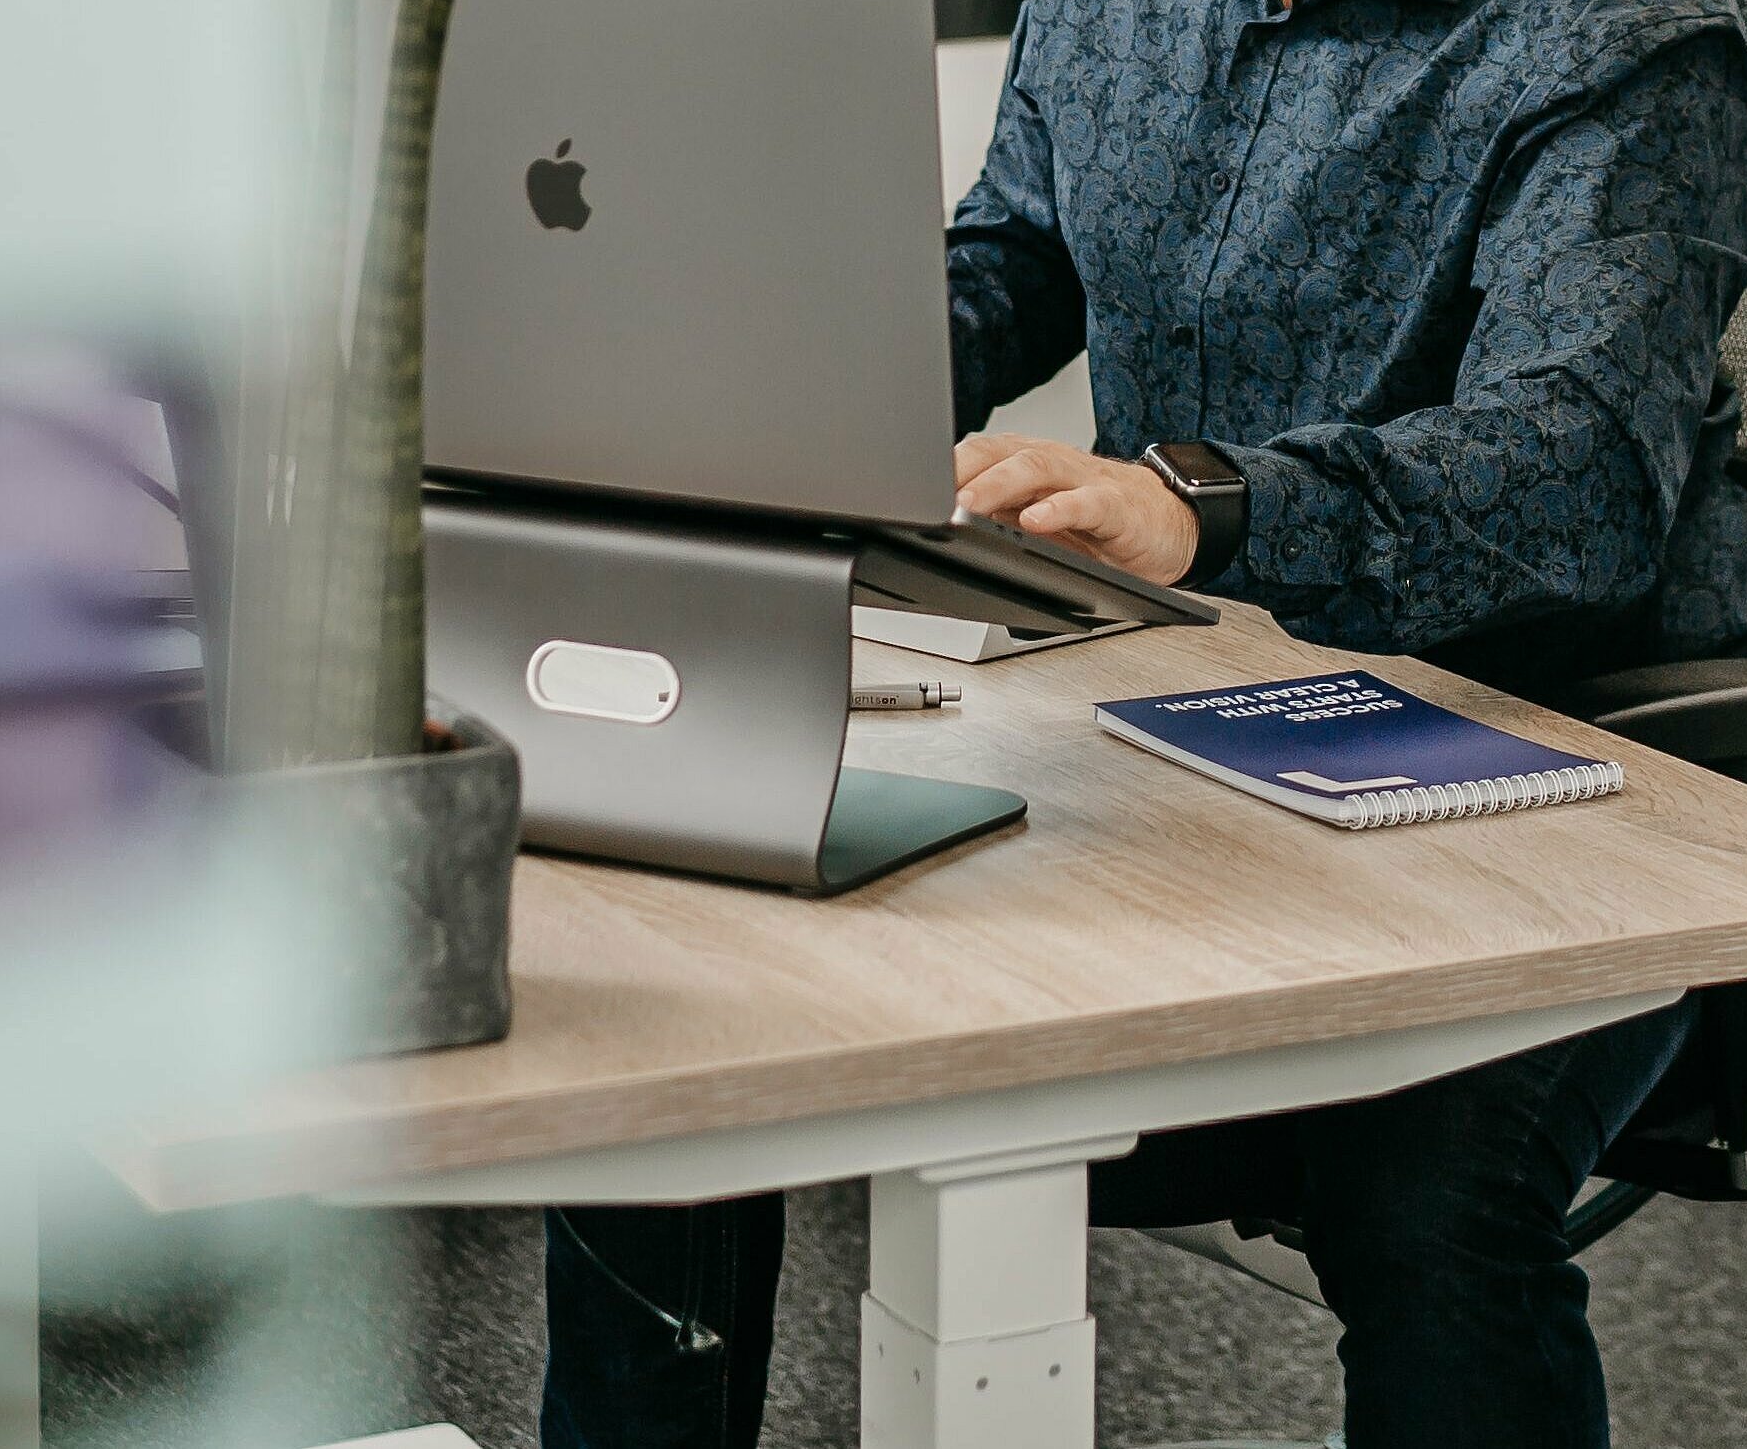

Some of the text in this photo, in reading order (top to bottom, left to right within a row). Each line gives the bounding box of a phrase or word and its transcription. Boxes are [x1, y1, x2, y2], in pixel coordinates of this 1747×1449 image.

[1155, 678, 1361, 712] A CLEAR VISION.
[1215, 689, 1383, 718] STARTS WITH
[1285, 699, 1403, 722] SUCCESS
